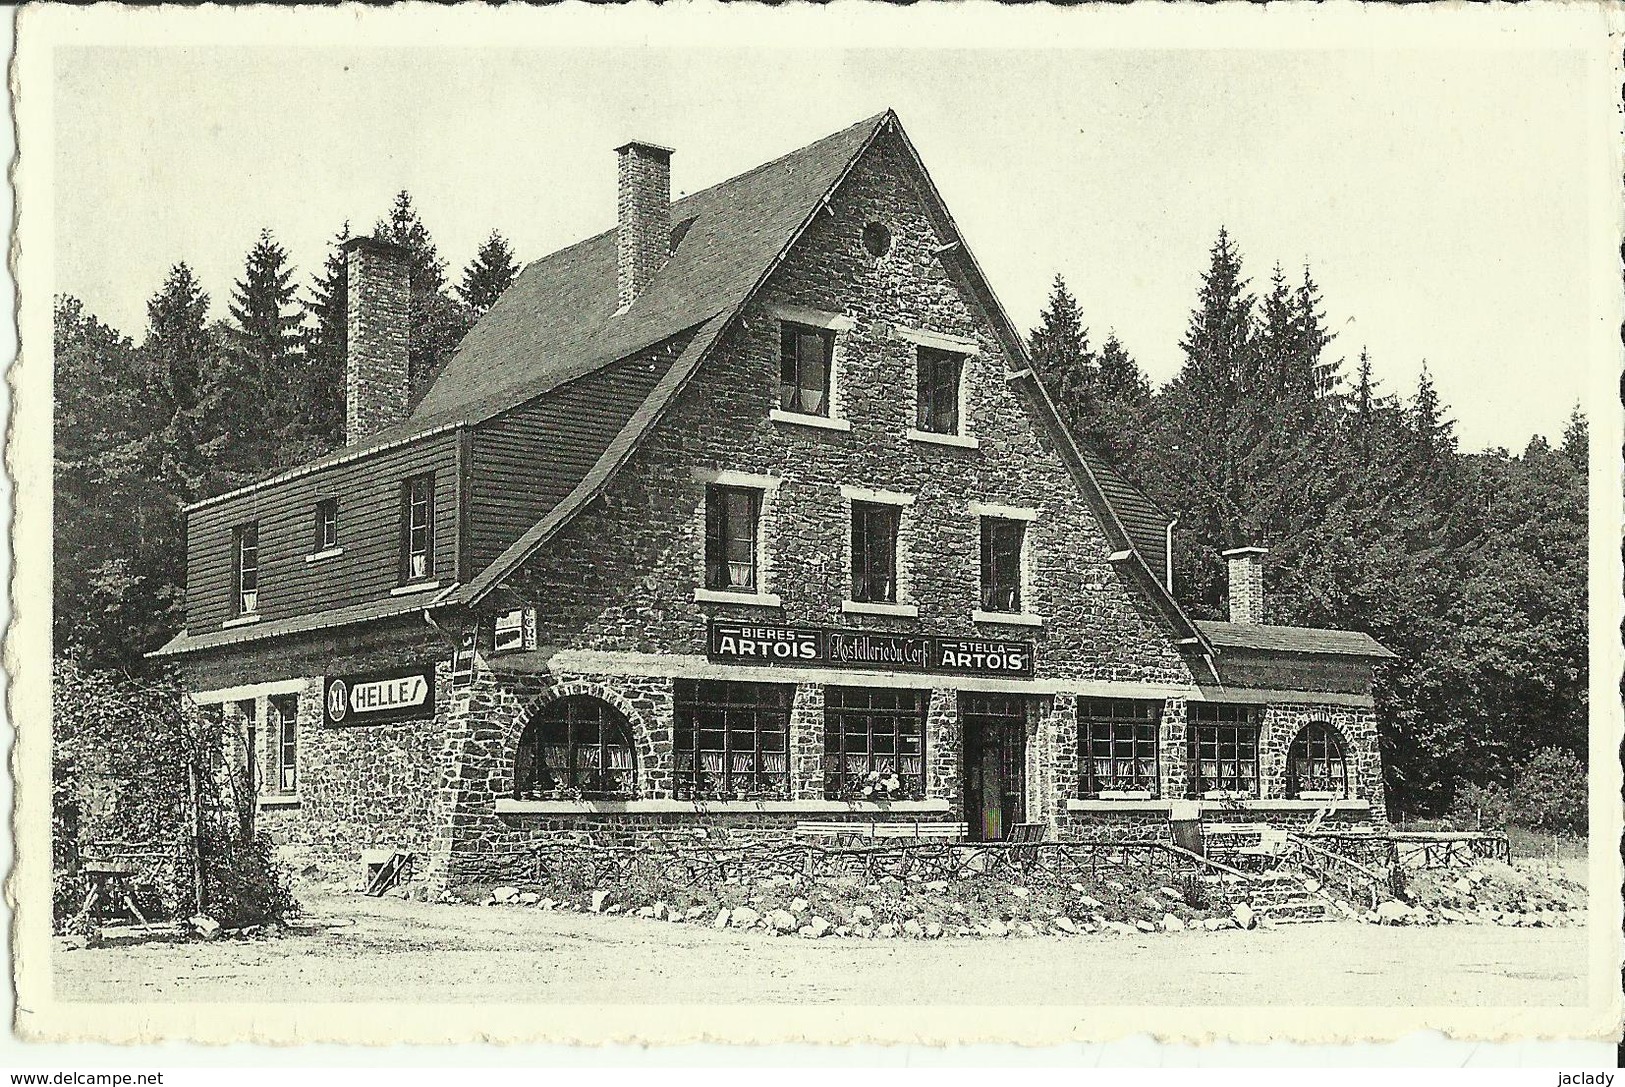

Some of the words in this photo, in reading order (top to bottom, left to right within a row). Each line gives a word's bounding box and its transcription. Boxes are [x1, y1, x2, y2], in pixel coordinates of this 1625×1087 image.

[741, 627, 796, 641] BIERES
[719, 636, 818, 660] ARTOIS
[958, 641, 1006, 654] STELLA
[941, 650, 1022, 670] ARTOIS
